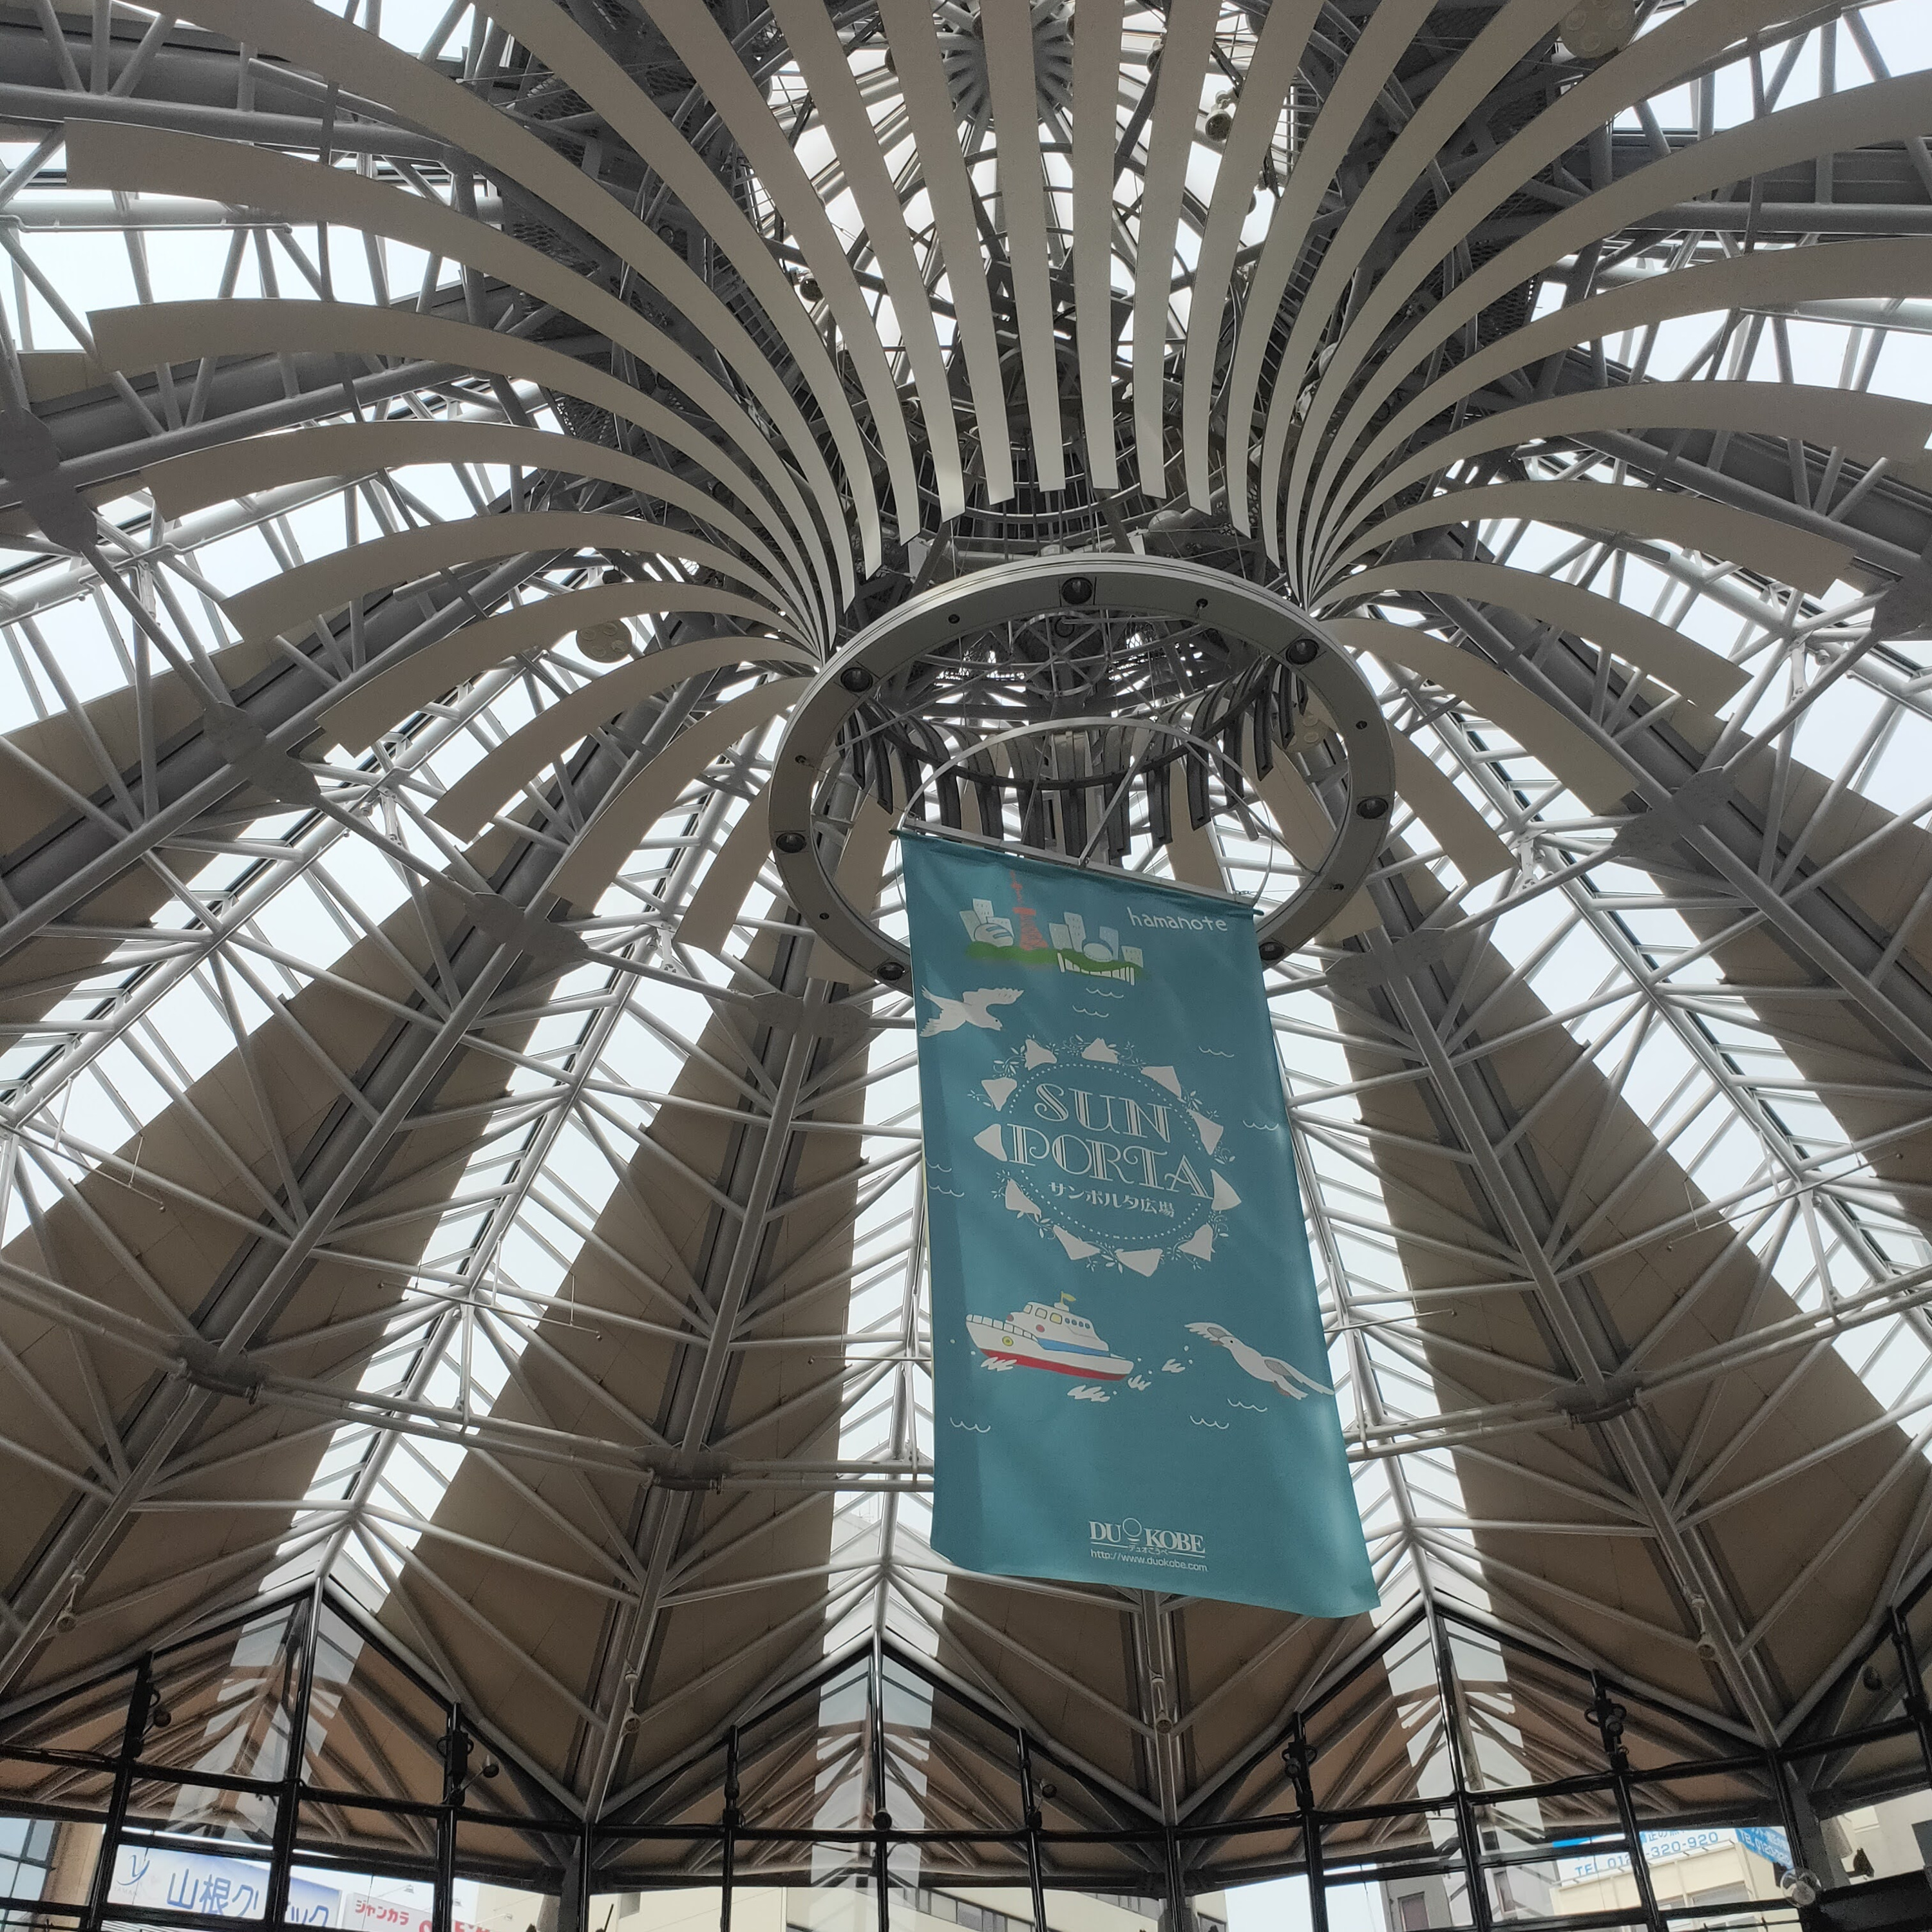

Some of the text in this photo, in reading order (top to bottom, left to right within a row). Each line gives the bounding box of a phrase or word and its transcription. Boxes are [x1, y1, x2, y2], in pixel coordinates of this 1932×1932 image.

[1127, 907, 1228, 932] hamanote
[1034, 1083, 1171, 1143] SUN
[1007, 1123, 1213, 1200] PORTA
[1048, 1182, 1175, 1218] サンポルタ広場
[1143, 1528, 1206, 1553] KOBE
[1090, 1548, 1208, 1572] http://www.duokobe.com
[355, 1899, 410, 1926] ジャンカラ
